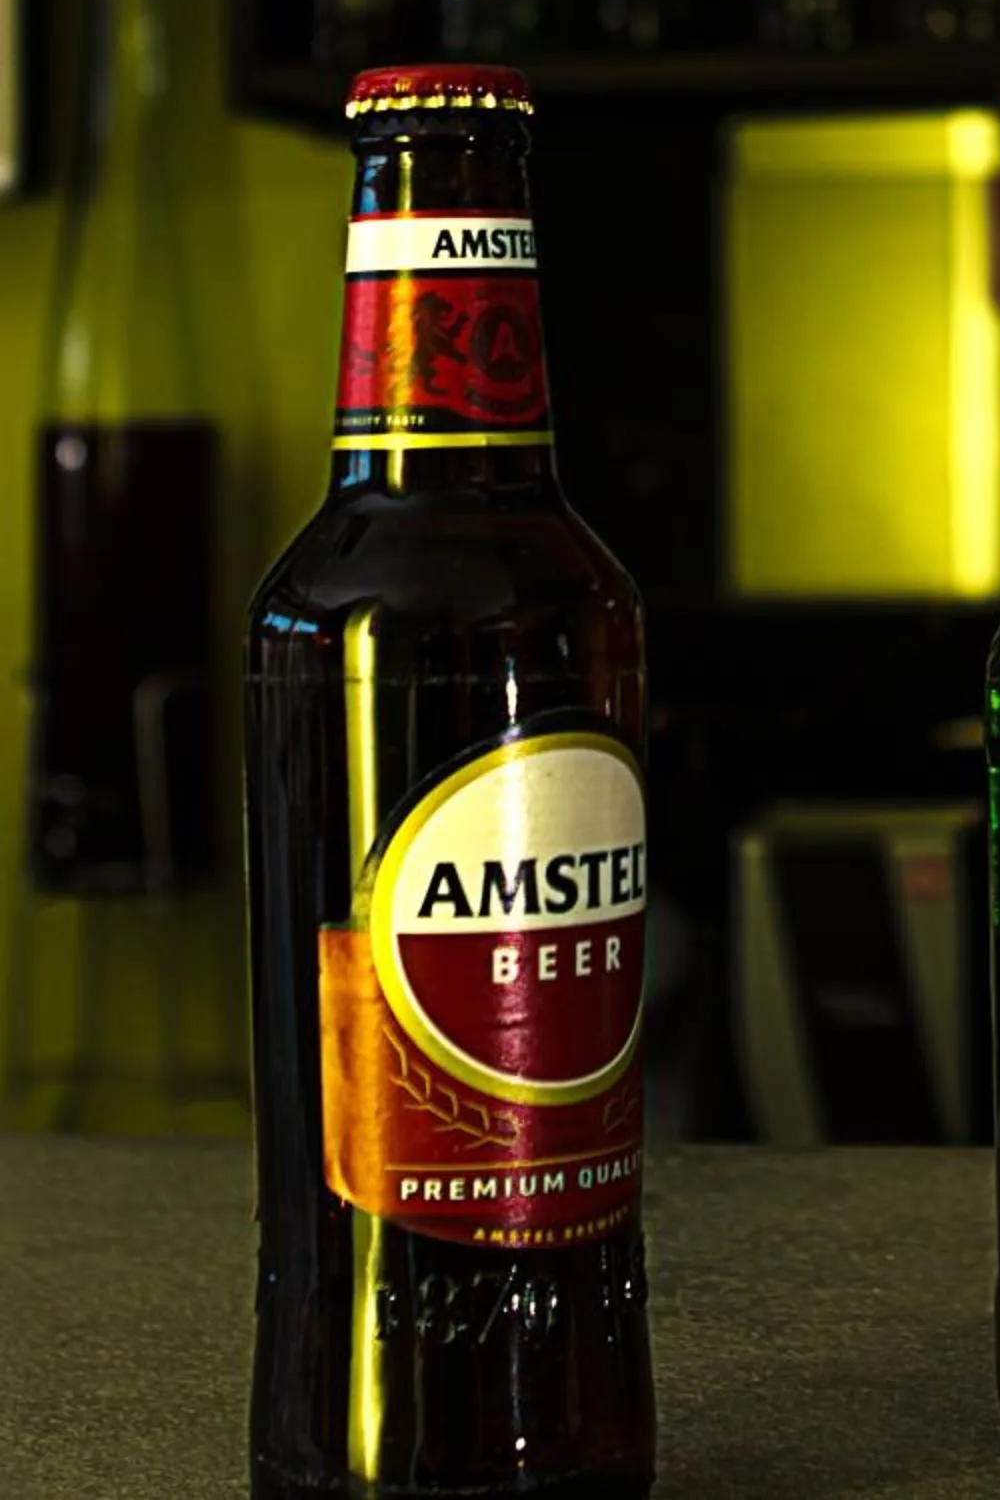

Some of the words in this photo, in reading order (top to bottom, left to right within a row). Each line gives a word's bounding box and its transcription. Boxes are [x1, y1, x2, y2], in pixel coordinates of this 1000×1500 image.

[417, 842, 643, 918] AMSTEL
[491, 934, 622, 985] BEER
[400, 1170, 566, 1202] PREMIUM
